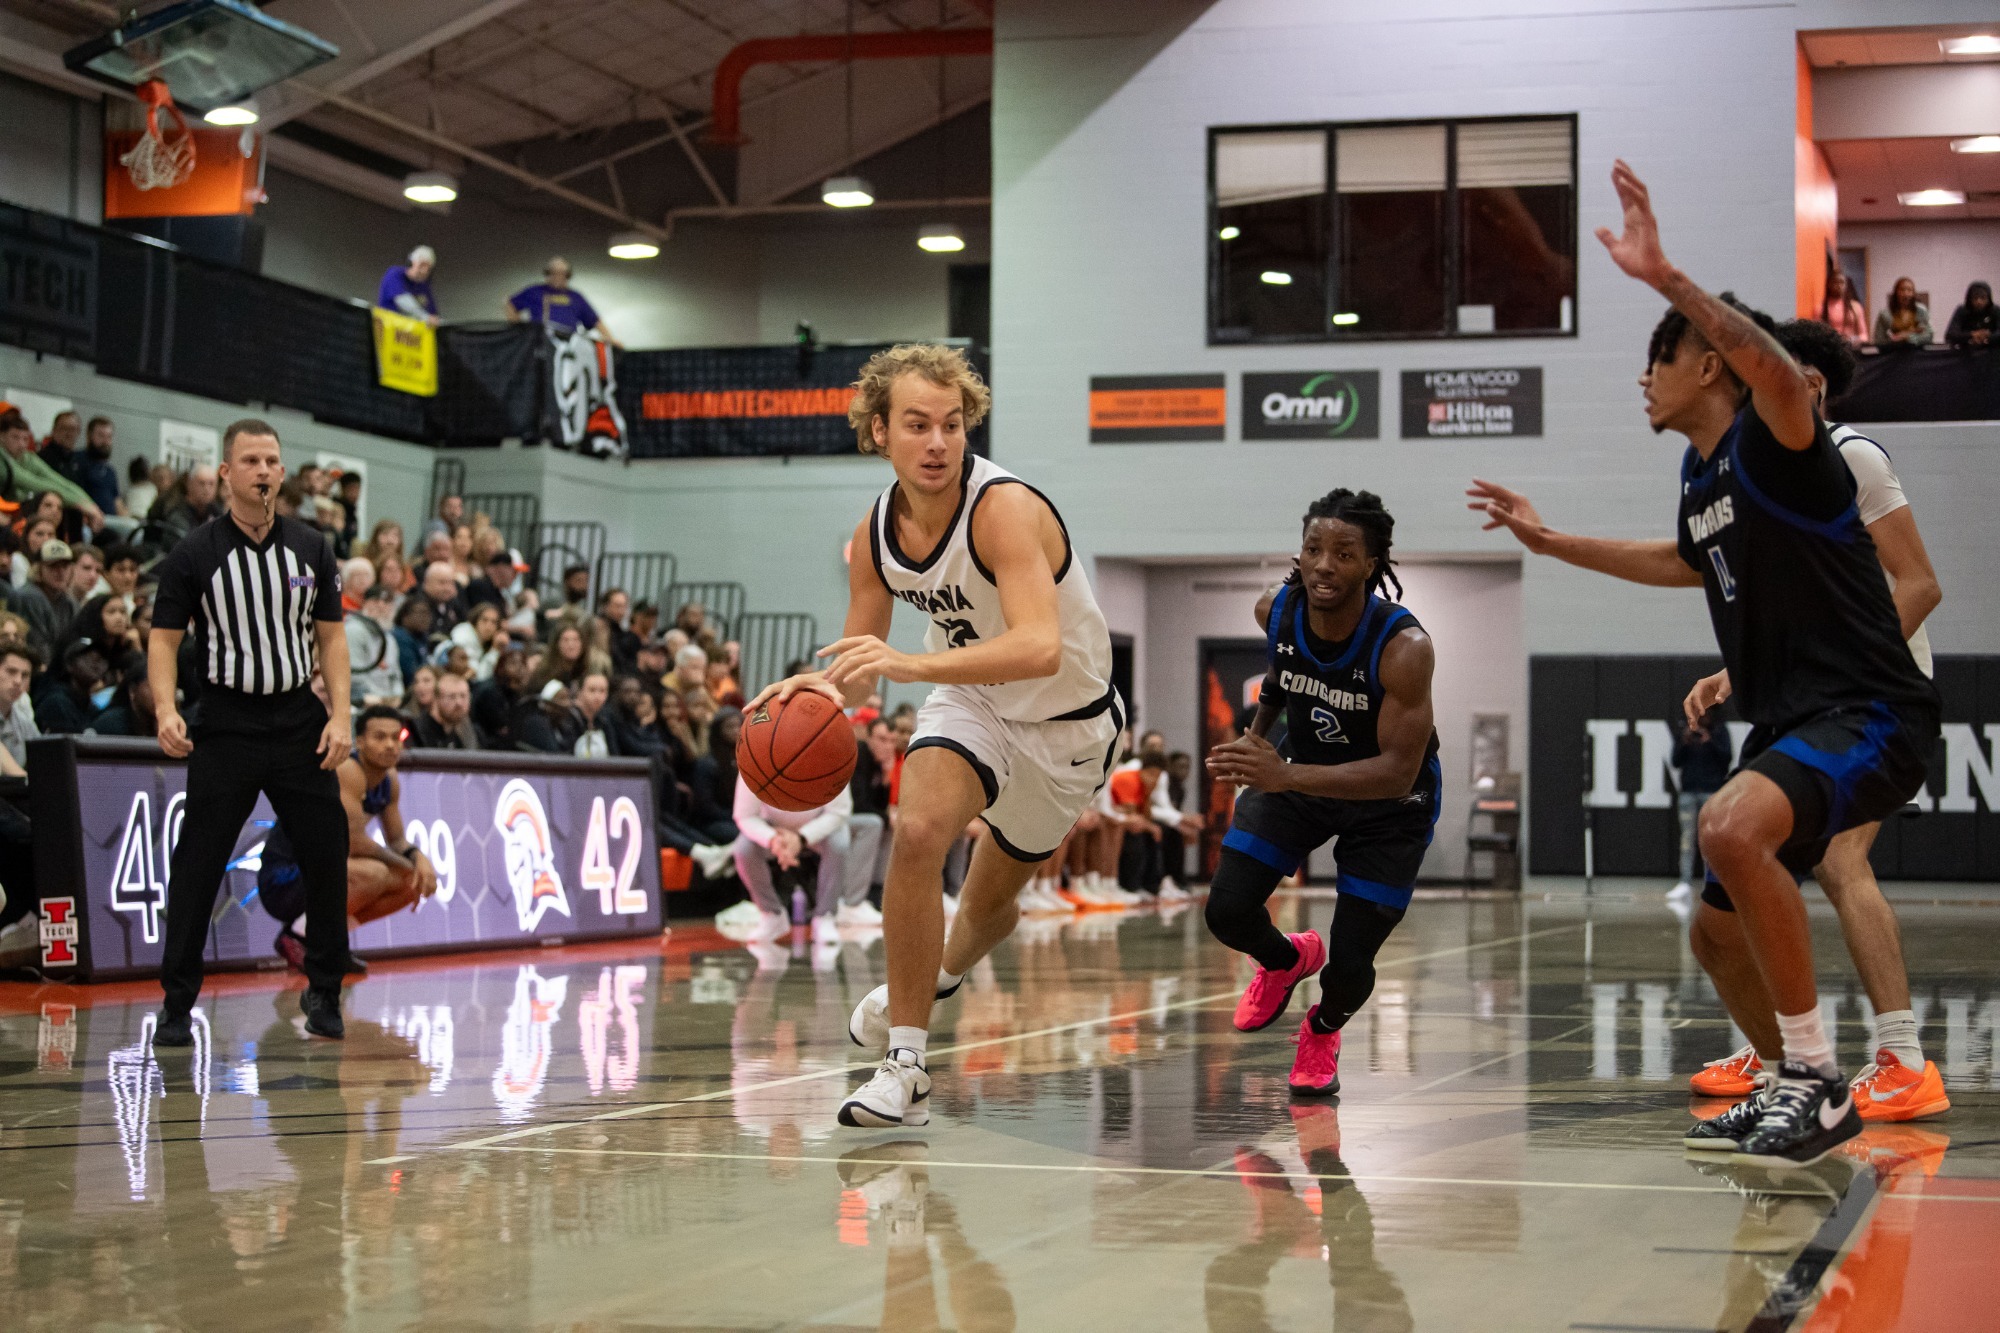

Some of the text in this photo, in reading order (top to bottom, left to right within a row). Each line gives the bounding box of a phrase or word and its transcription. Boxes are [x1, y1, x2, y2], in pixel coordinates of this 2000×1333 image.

[1261, 390, 1345, 419] Omni
[1446, 401, 1513, 421] Hilton
[1279, 669, 1369, 711] COUGARS
[1310, 706, 1350, 744] 2
[581, 796, 648, 915] 42
[45, 926, 74, 937] TECH
